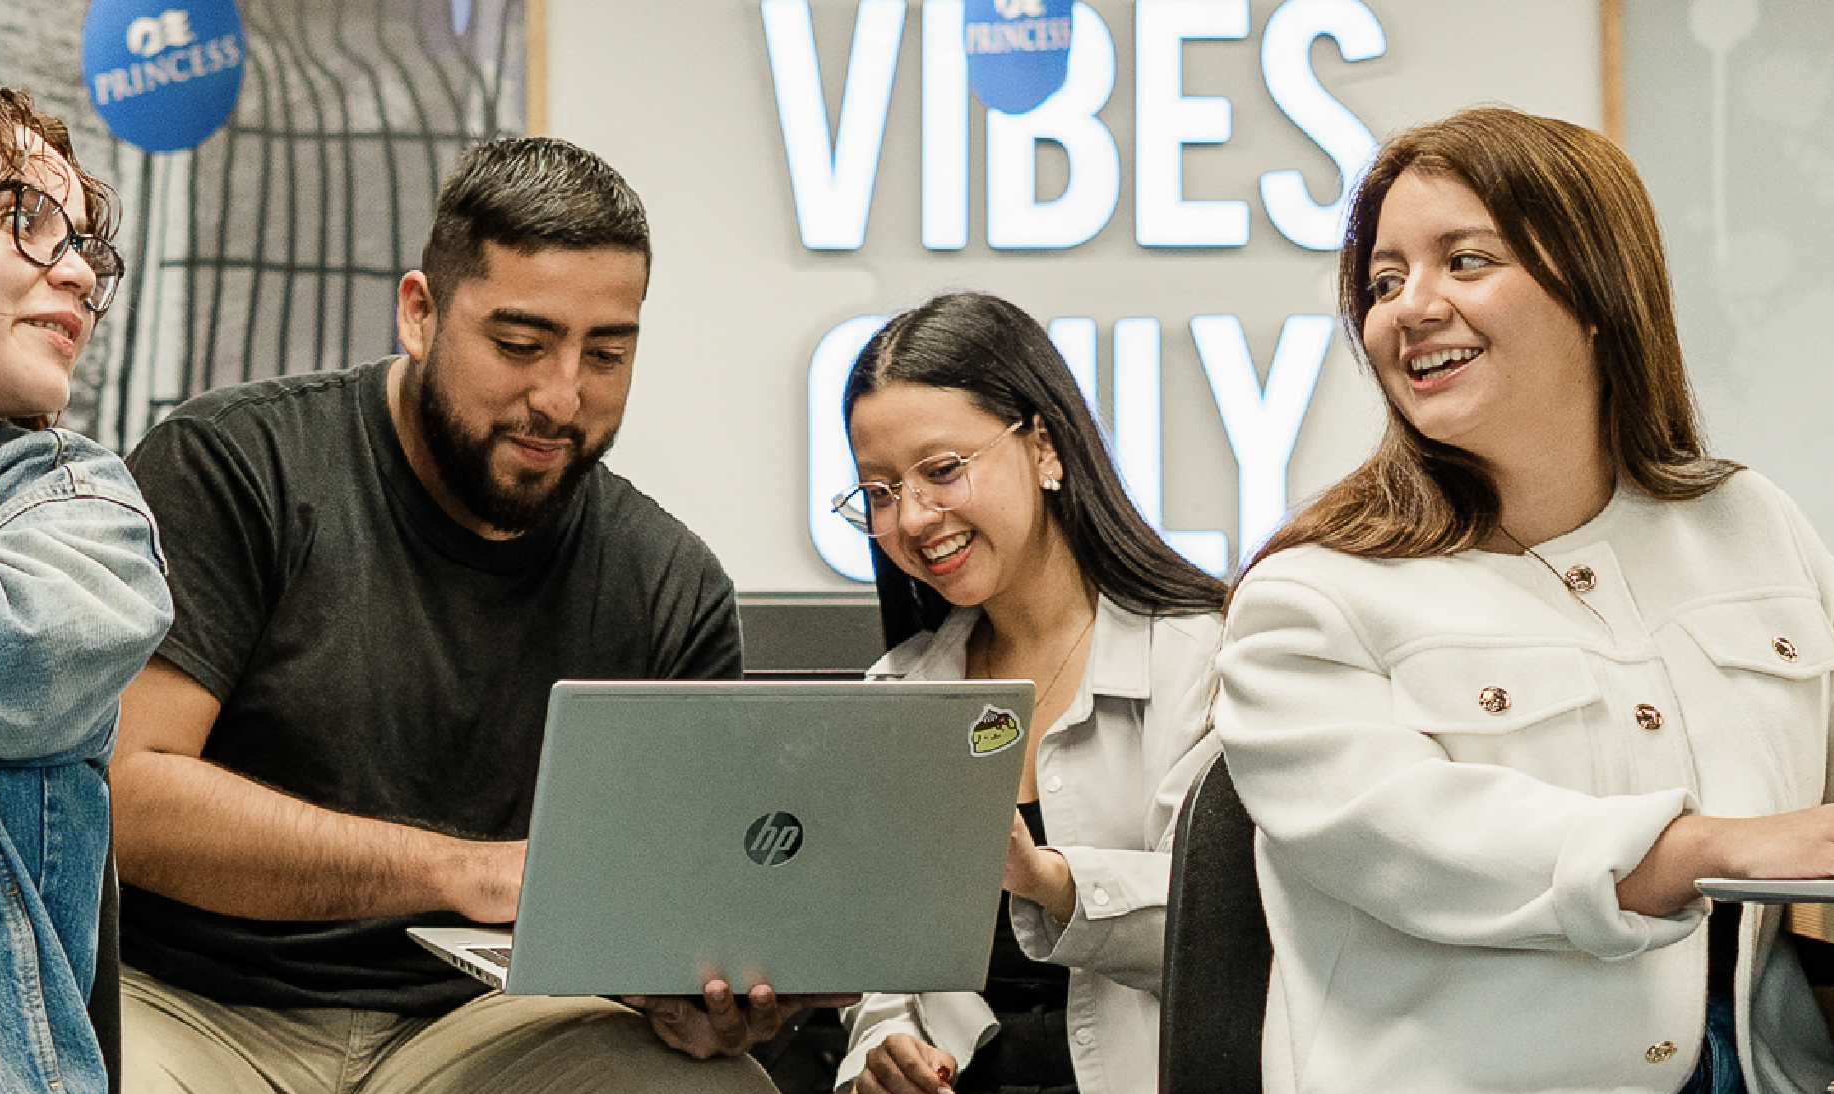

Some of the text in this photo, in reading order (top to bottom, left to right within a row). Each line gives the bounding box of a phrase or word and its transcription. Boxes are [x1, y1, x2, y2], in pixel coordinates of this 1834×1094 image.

[94, 35, 240, 105] PRINCESS
[761, 0, 1387, 250] VIBES
[748, 811, 800, 866] hp
